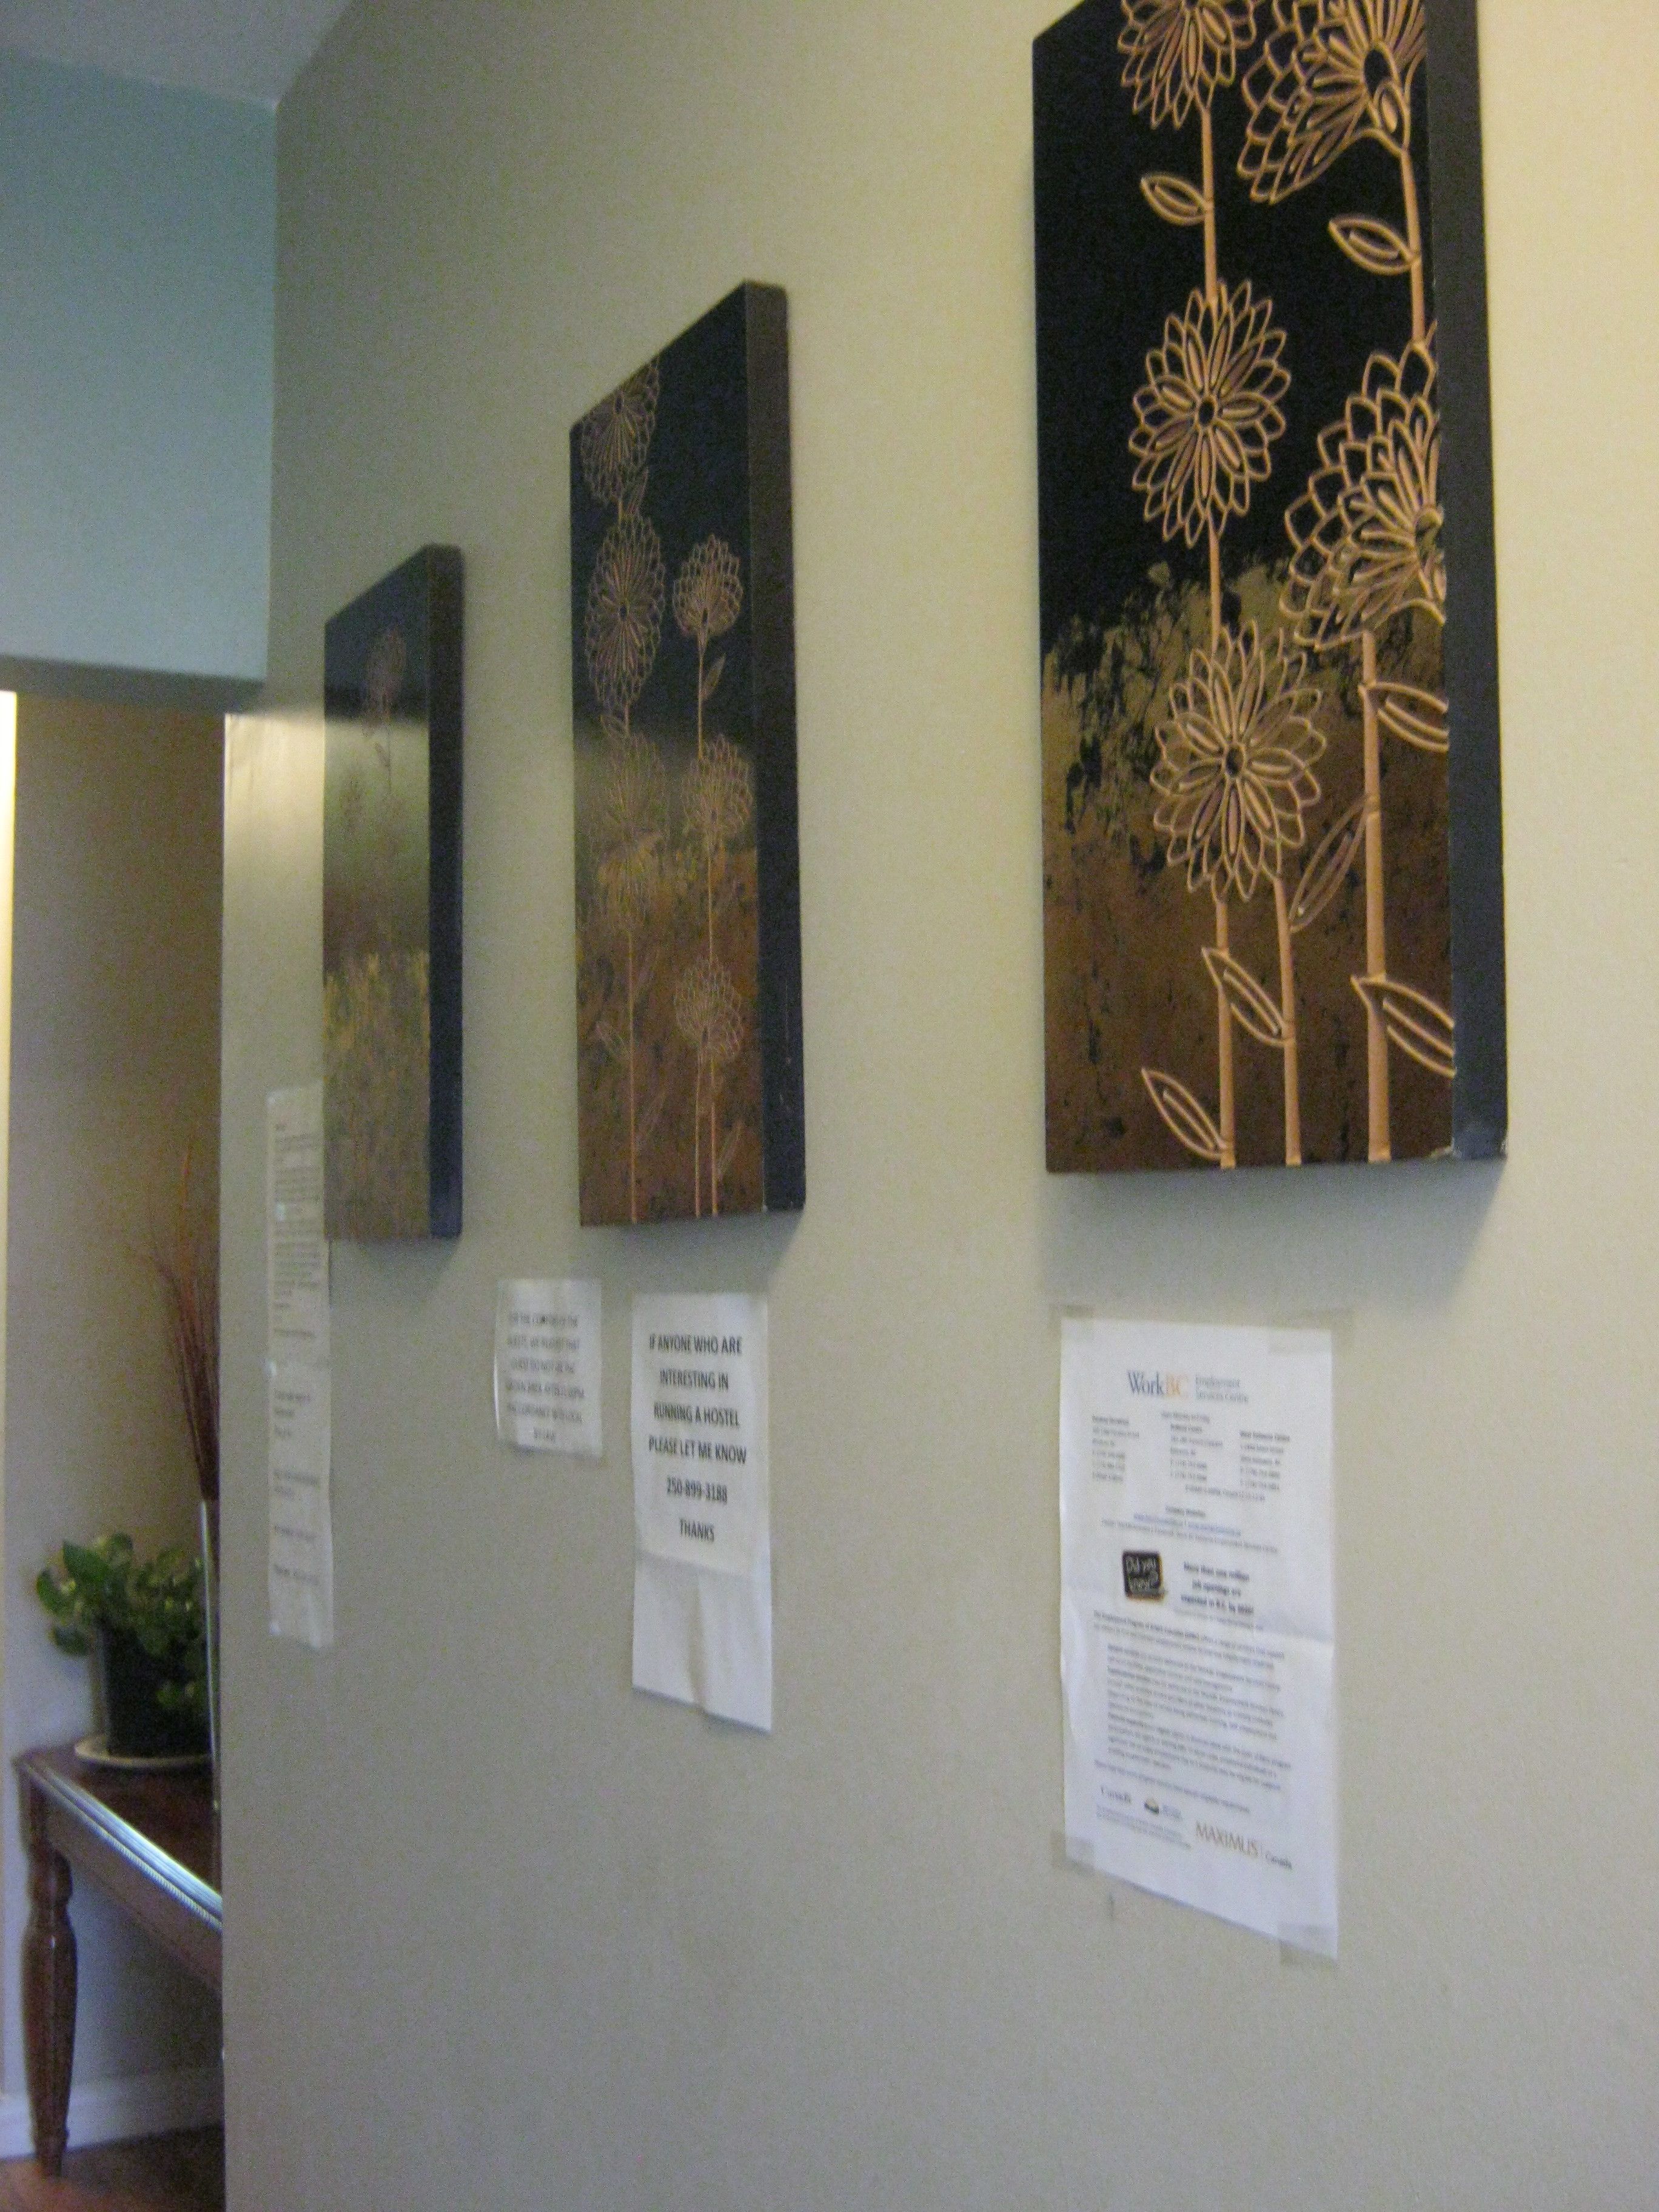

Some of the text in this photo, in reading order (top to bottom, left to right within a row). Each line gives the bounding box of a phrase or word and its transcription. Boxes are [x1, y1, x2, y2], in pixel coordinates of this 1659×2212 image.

[649, 1333, 742, 1355] IF ANYONE WHO ARE
[660, 1369, 728, 1390] INTERESTING IN
[654, 1403, 739, 1427] RUNNING A HOSTEL
[649, 1435, 746, 1464] PLEASE LET ME KNOW
[680, 1518, 714, 1542] THANKS
[1196, 1820, 1259, 1858] MAXIMUS
